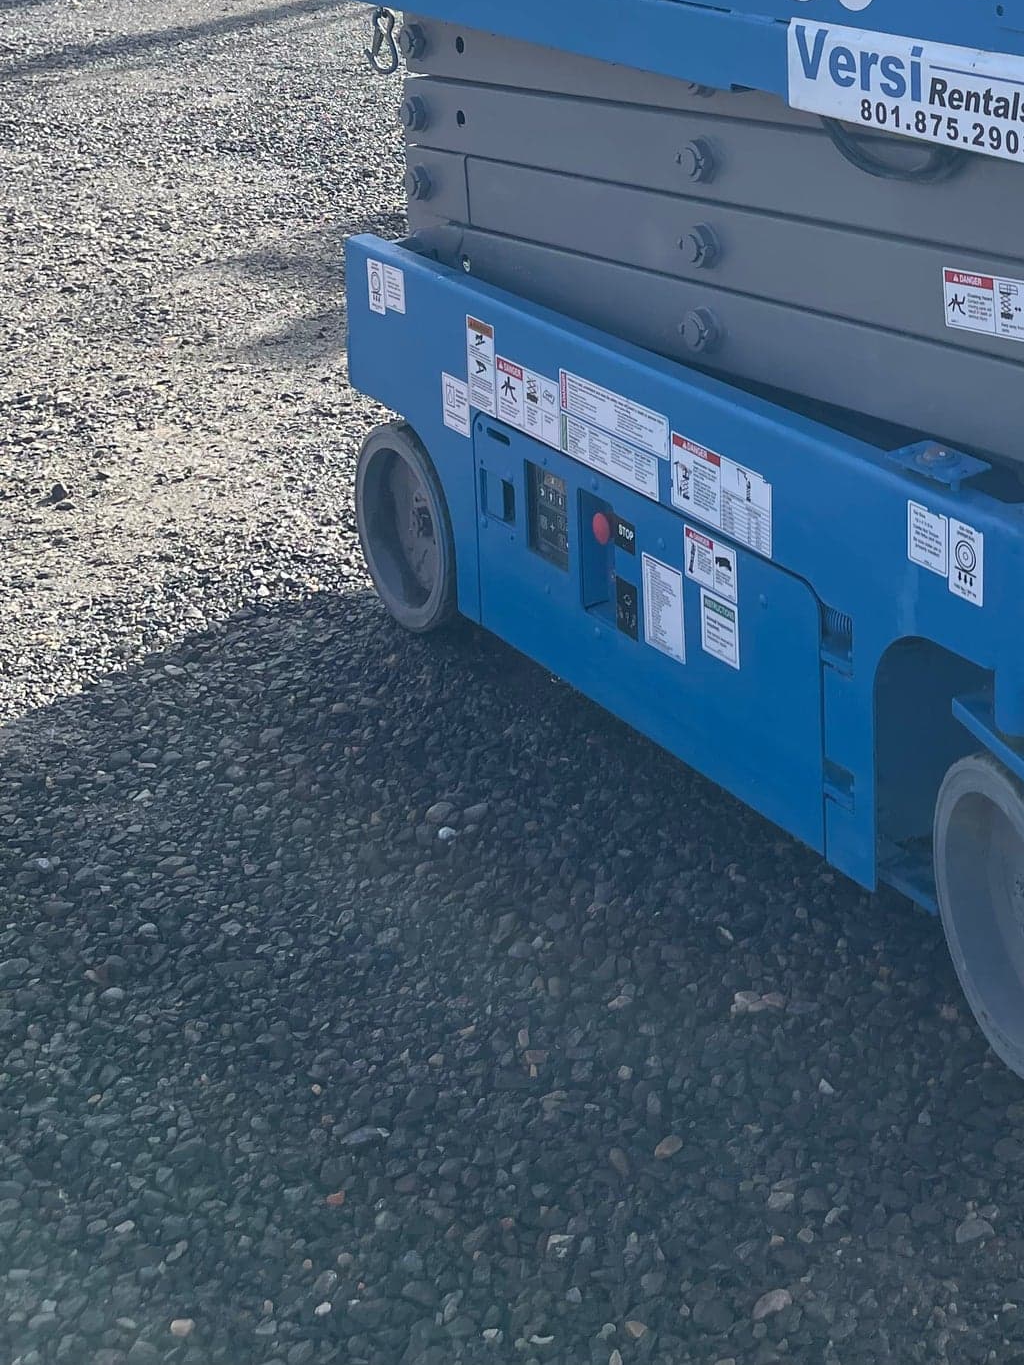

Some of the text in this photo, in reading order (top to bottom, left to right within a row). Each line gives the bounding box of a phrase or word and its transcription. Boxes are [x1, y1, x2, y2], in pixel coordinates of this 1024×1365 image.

[795, 24, 924, 103] Versi
[959, 275, 982, 286] DANGER
[618, 524, 634, 541] STOP
